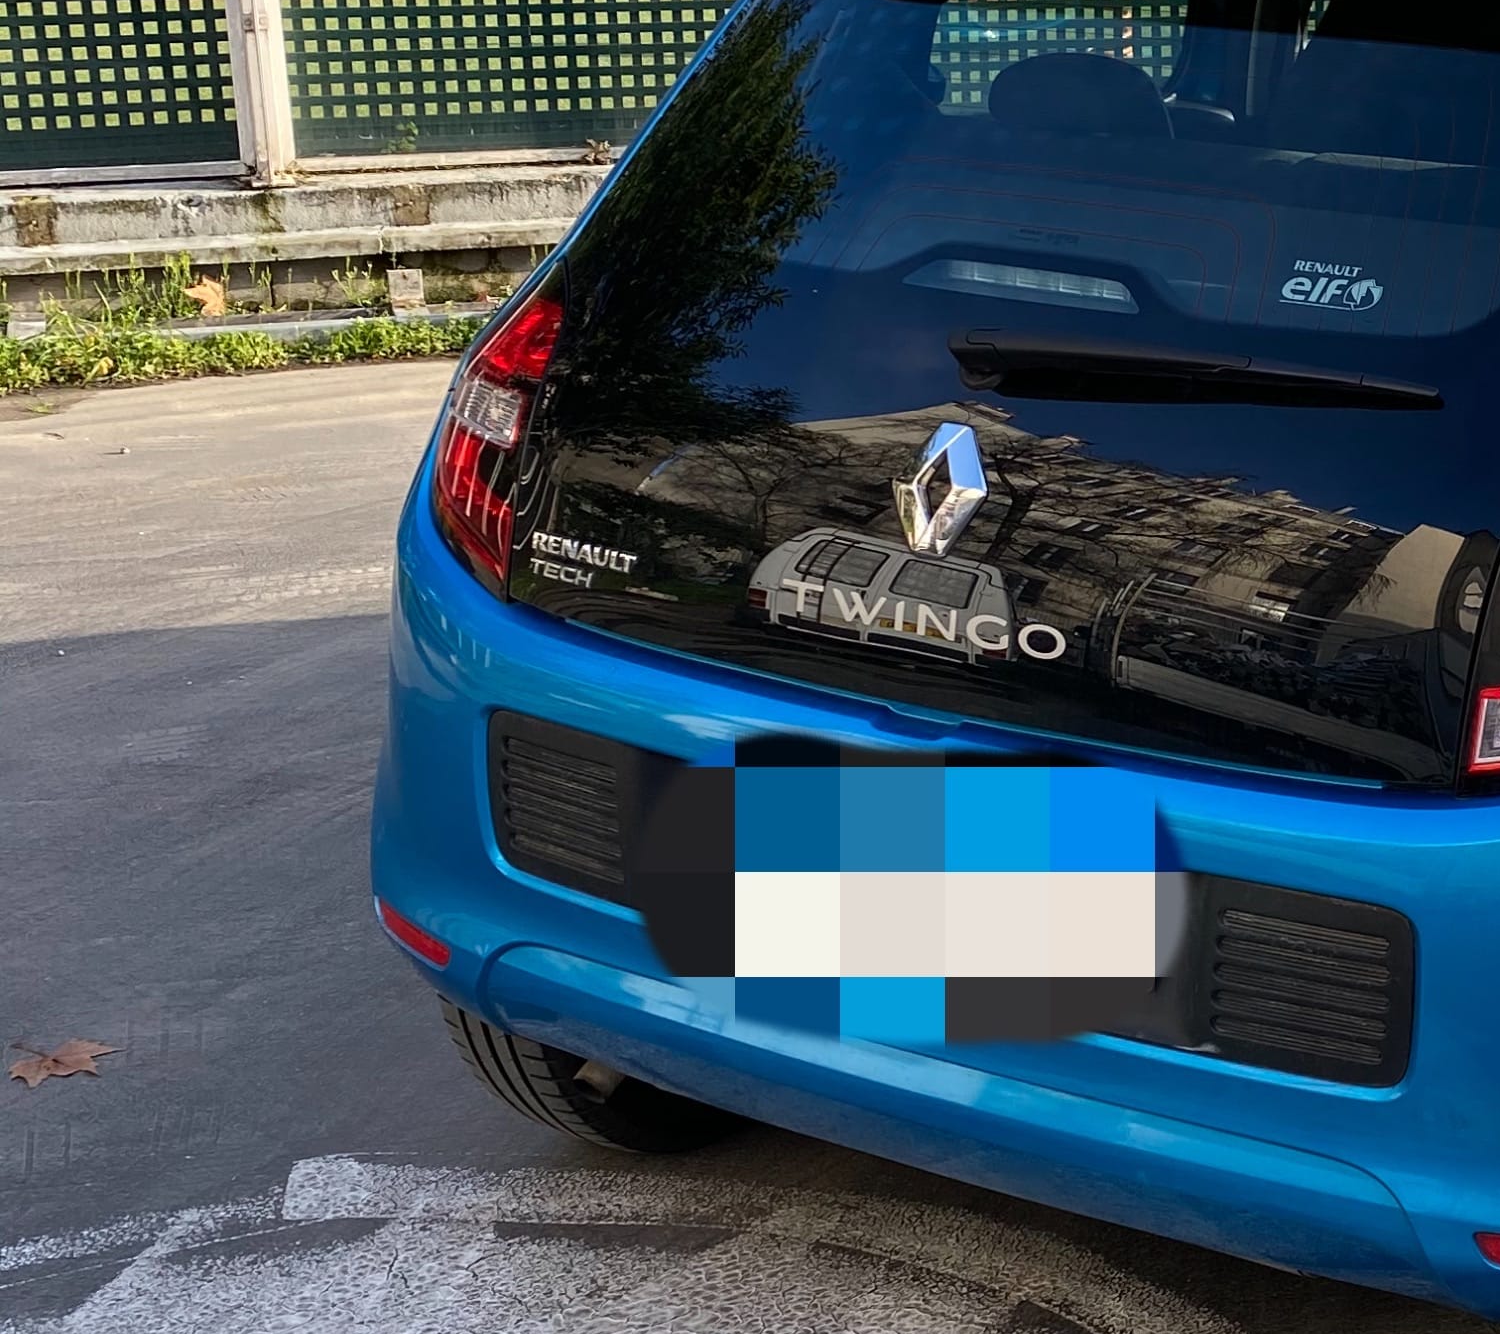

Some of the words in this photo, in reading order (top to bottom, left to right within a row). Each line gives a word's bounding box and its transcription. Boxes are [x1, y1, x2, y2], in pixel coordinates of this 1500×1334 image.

[1293, 259, 1362, 277] RENAULT
[1280, 276, 1349, 304] elf
[532, 531, 637, 574] RENAULT
[529, 558, 594, 588] TECH
[782, 578, 1066, 660] TWINGO
